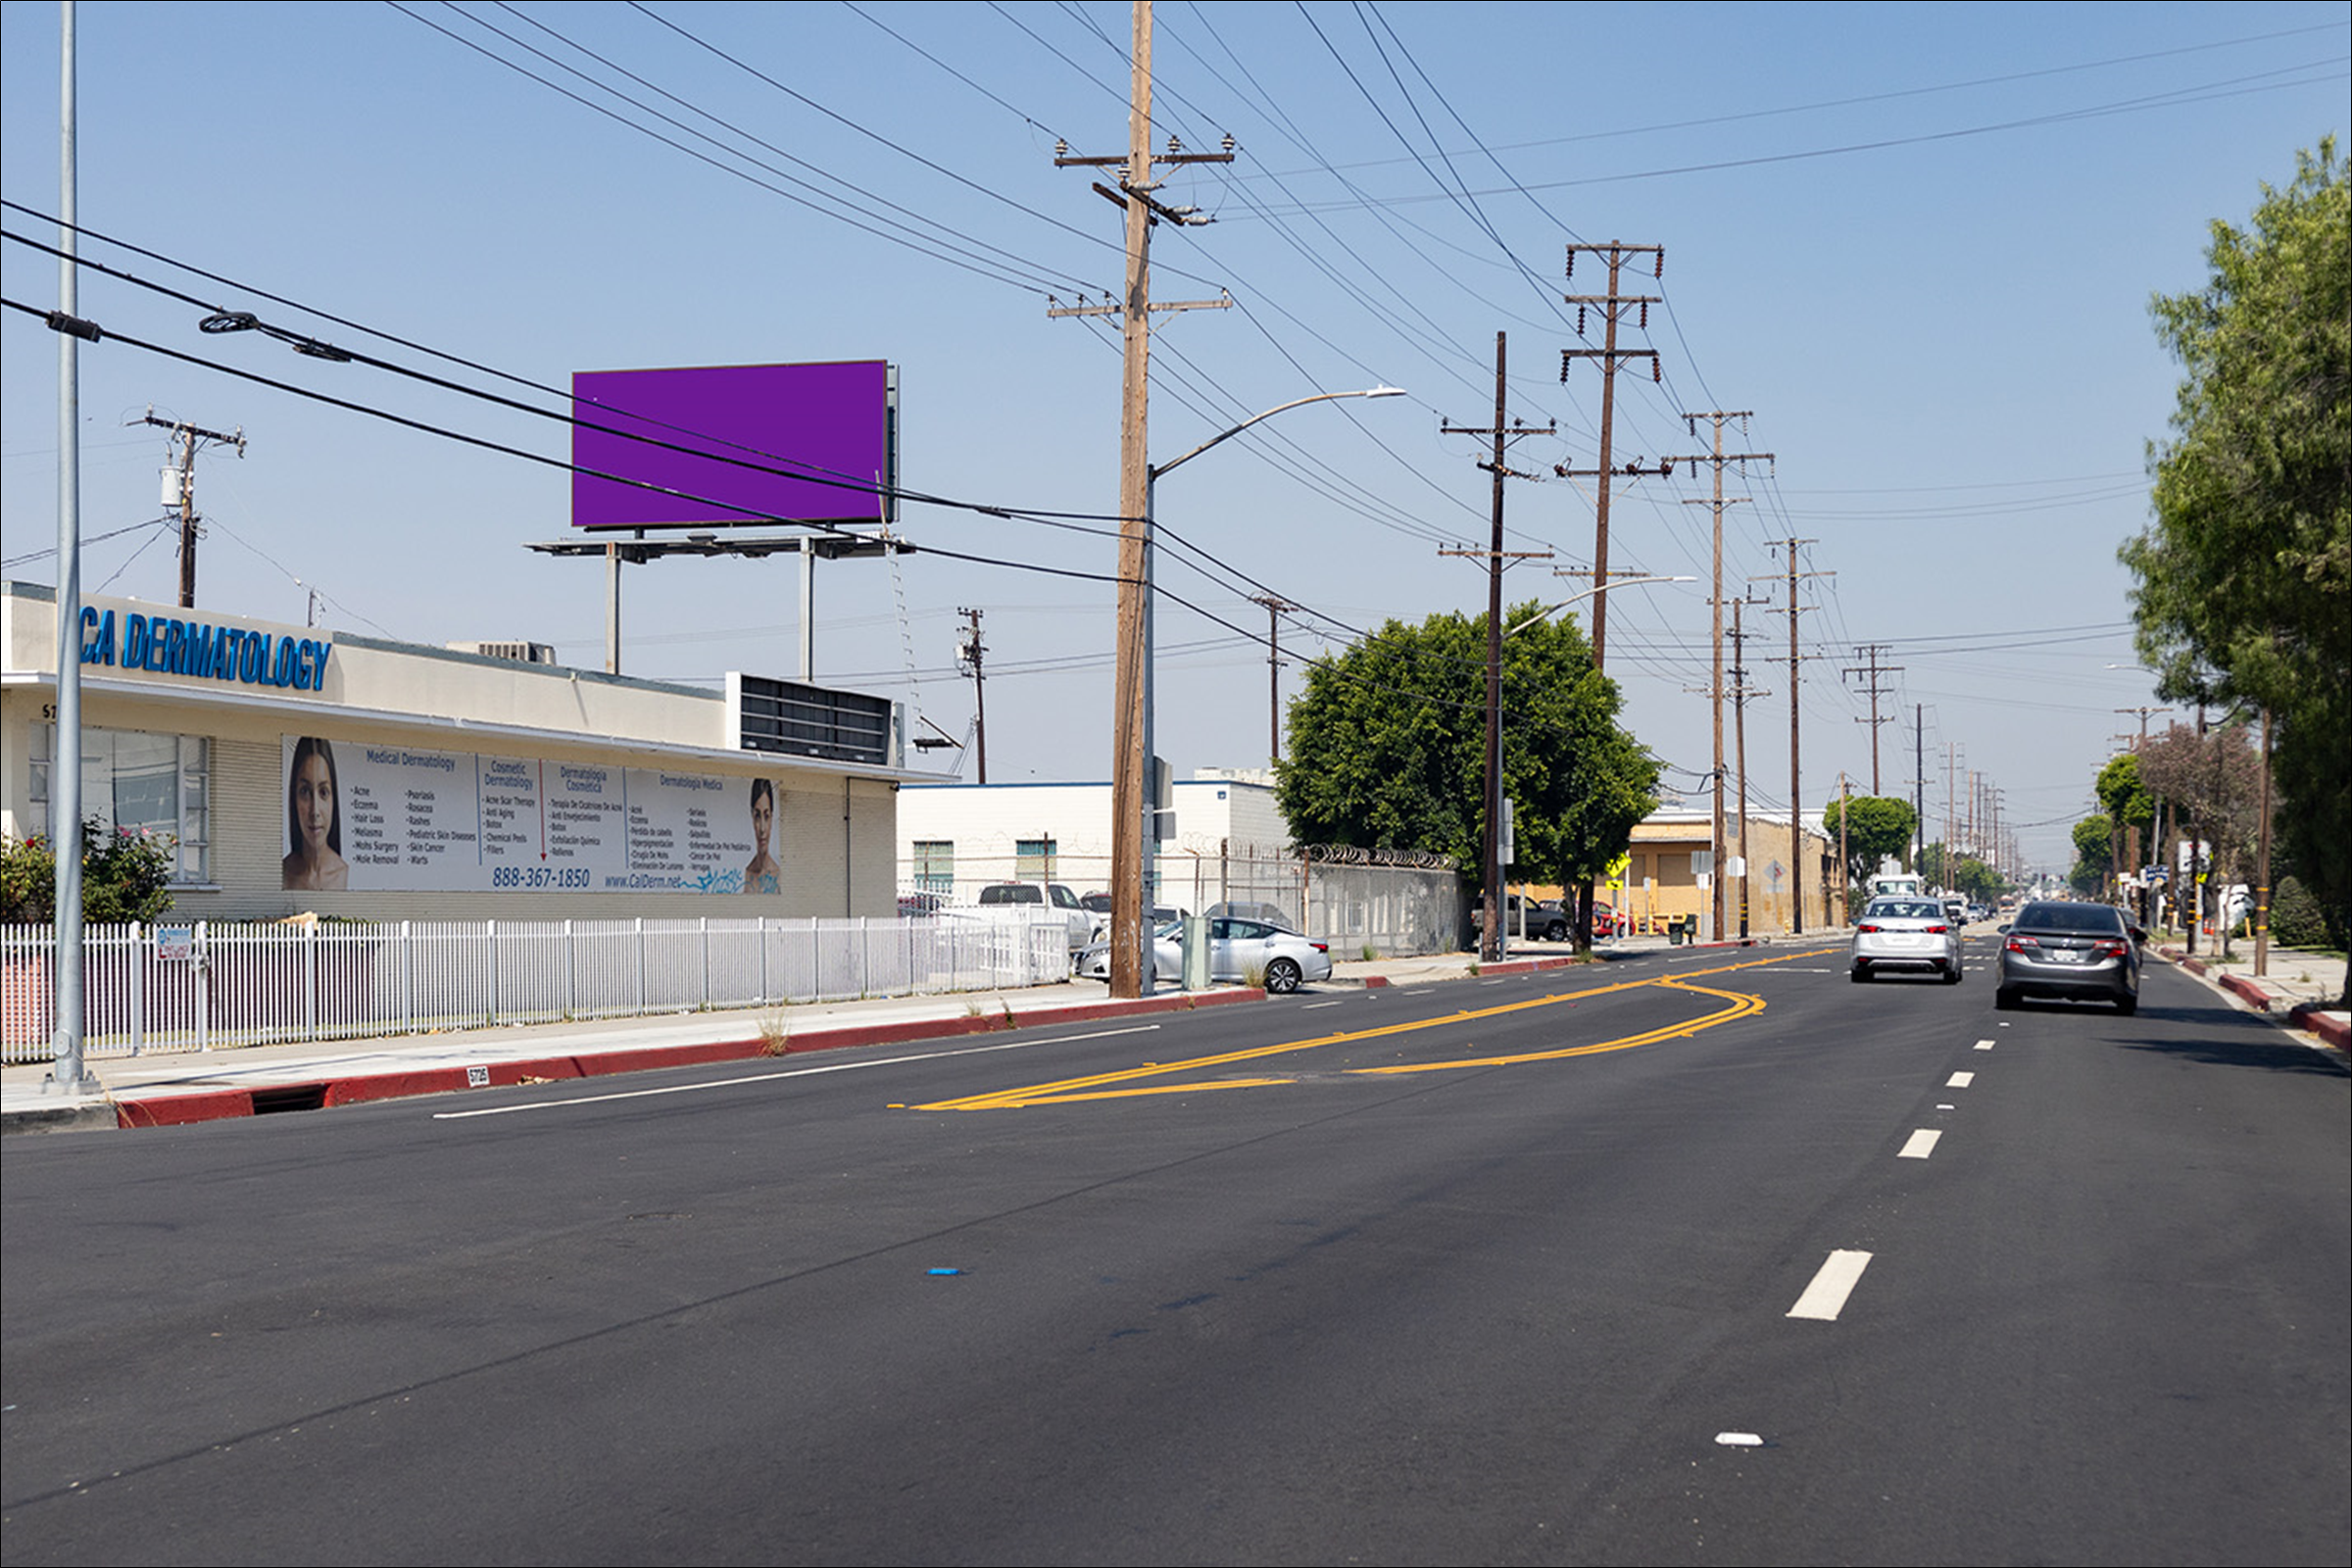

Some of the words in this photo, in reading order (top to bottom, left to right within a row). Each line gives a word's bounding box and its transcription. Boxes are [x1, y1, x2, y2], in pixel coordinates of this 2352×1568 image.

[79, 607, 115, 665] CA
[122, 613, 332, 691] DERMATOLOGY
[367, 750, 400, 765] Medical
[402, 753, 456, 772] Dermatology
[491, 760, 526, 775] Cosmetic
[484, 773, 533, 791] Dermatology
[354, 786, 370, 797] Acne
[408, 790, 435, 801] Psoriasis
[354, 799, 378, 810] Eczema
[485, 796, 499, 805] Acne
[514, 796, 535, 808] Therapy
[408, 804, 433, 813] Rosacea
[499, 808, 515, 820] Aging
[354, 814, 368, 823] Hair
[369, 814, 384, 823] Loss
[409, 815, 431, 826] Rashes
[486, 819, 502, 828] Botox
[355, 828, 383, 838] Melasma
[409, 829, 435, 840] Pediatric
[437, 830, 450, 841] Skin
[451, 831, 476, 841] Diseases
[486, 832, 512, 842] Chemical
[355, 841, 372, 851] Mohs
[373, 841, 399, 854] Surgery
[410, 843, 423, 853] Skin
[424, 843, 445, 853] Cancer
[486, 845, 505, 855] Fillers
[356, 855, 371, 864] Mole
[372, 855, 400, 864] Removal
[411, 856, 428, 864] Warts
[492, 867, 590, 888] 888-367-1850
[605, 874, 681, 889] www.CalDerm.net
